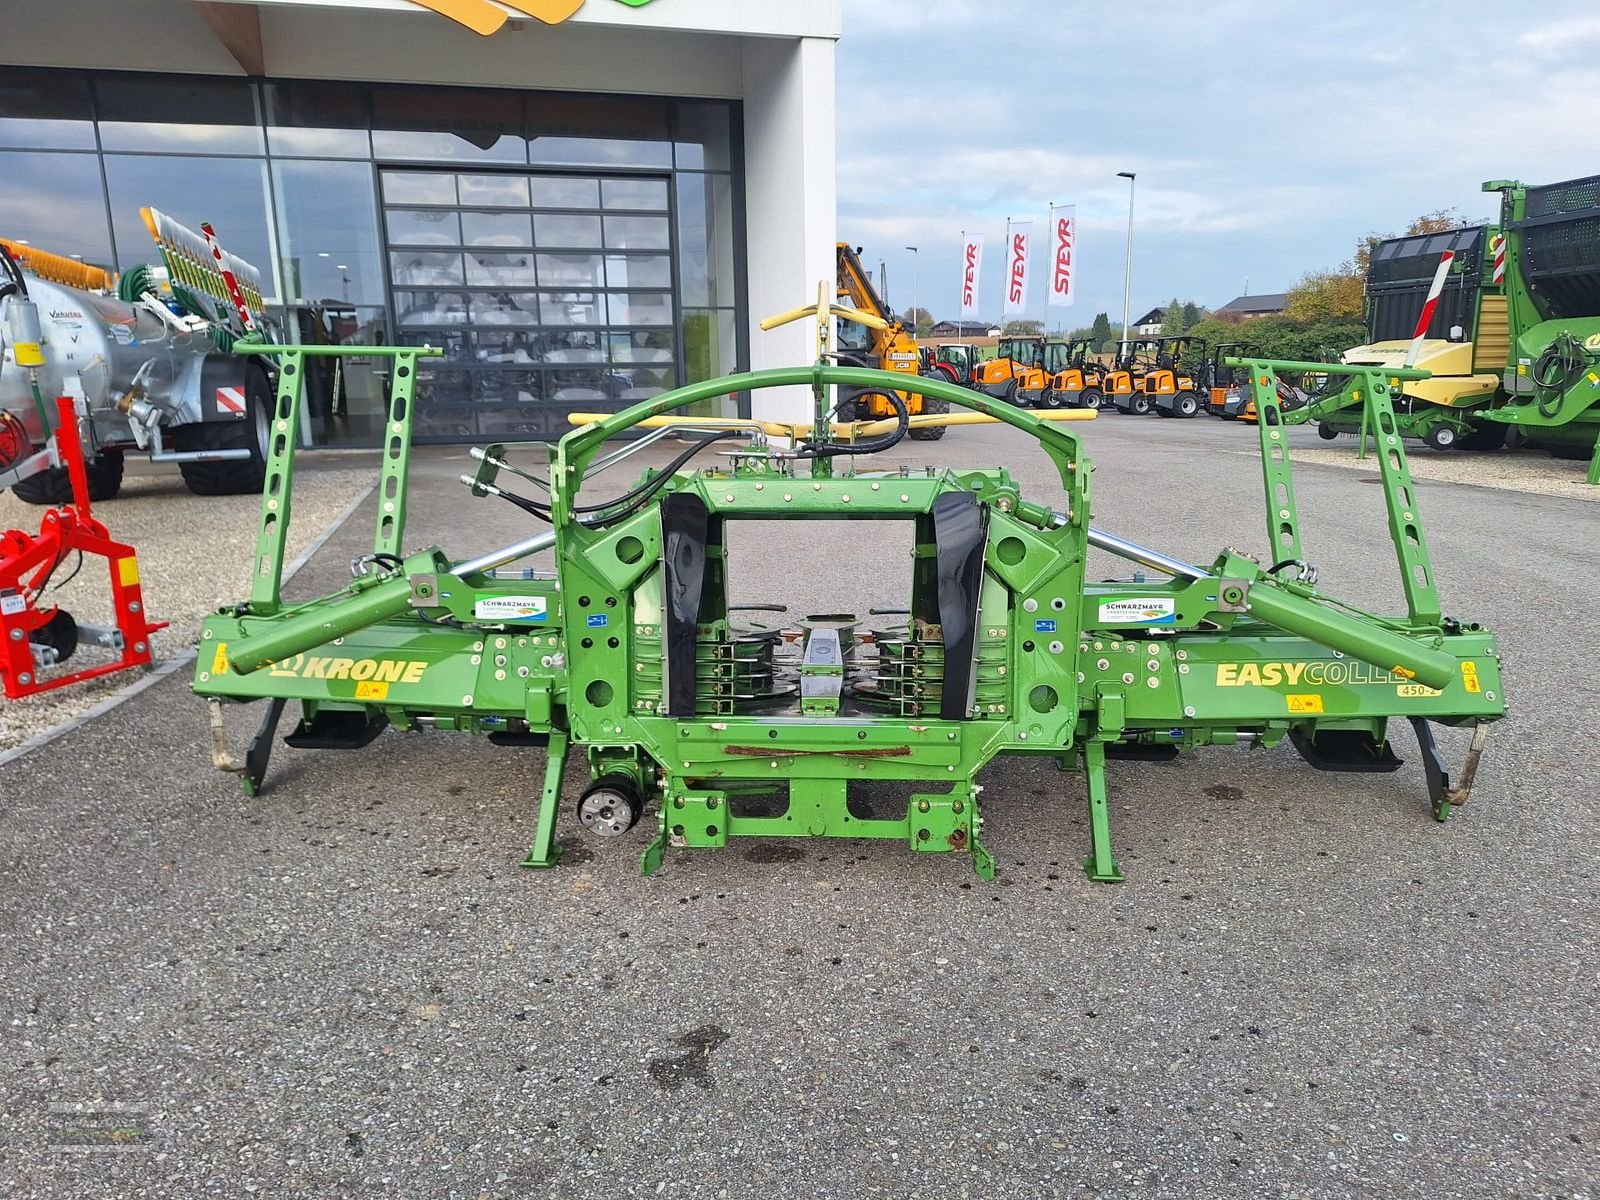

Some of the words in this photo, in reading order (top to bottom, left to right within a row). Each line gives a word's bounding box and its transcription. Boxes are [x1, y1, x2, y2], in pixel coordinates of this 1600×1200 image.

[963, 243, 977, 307] STEYR
[1010, 233, 1025, 305] STEYR
[1055, 218, 1071, 296] STEYR
[302, 657, 429, 683] KRONE
